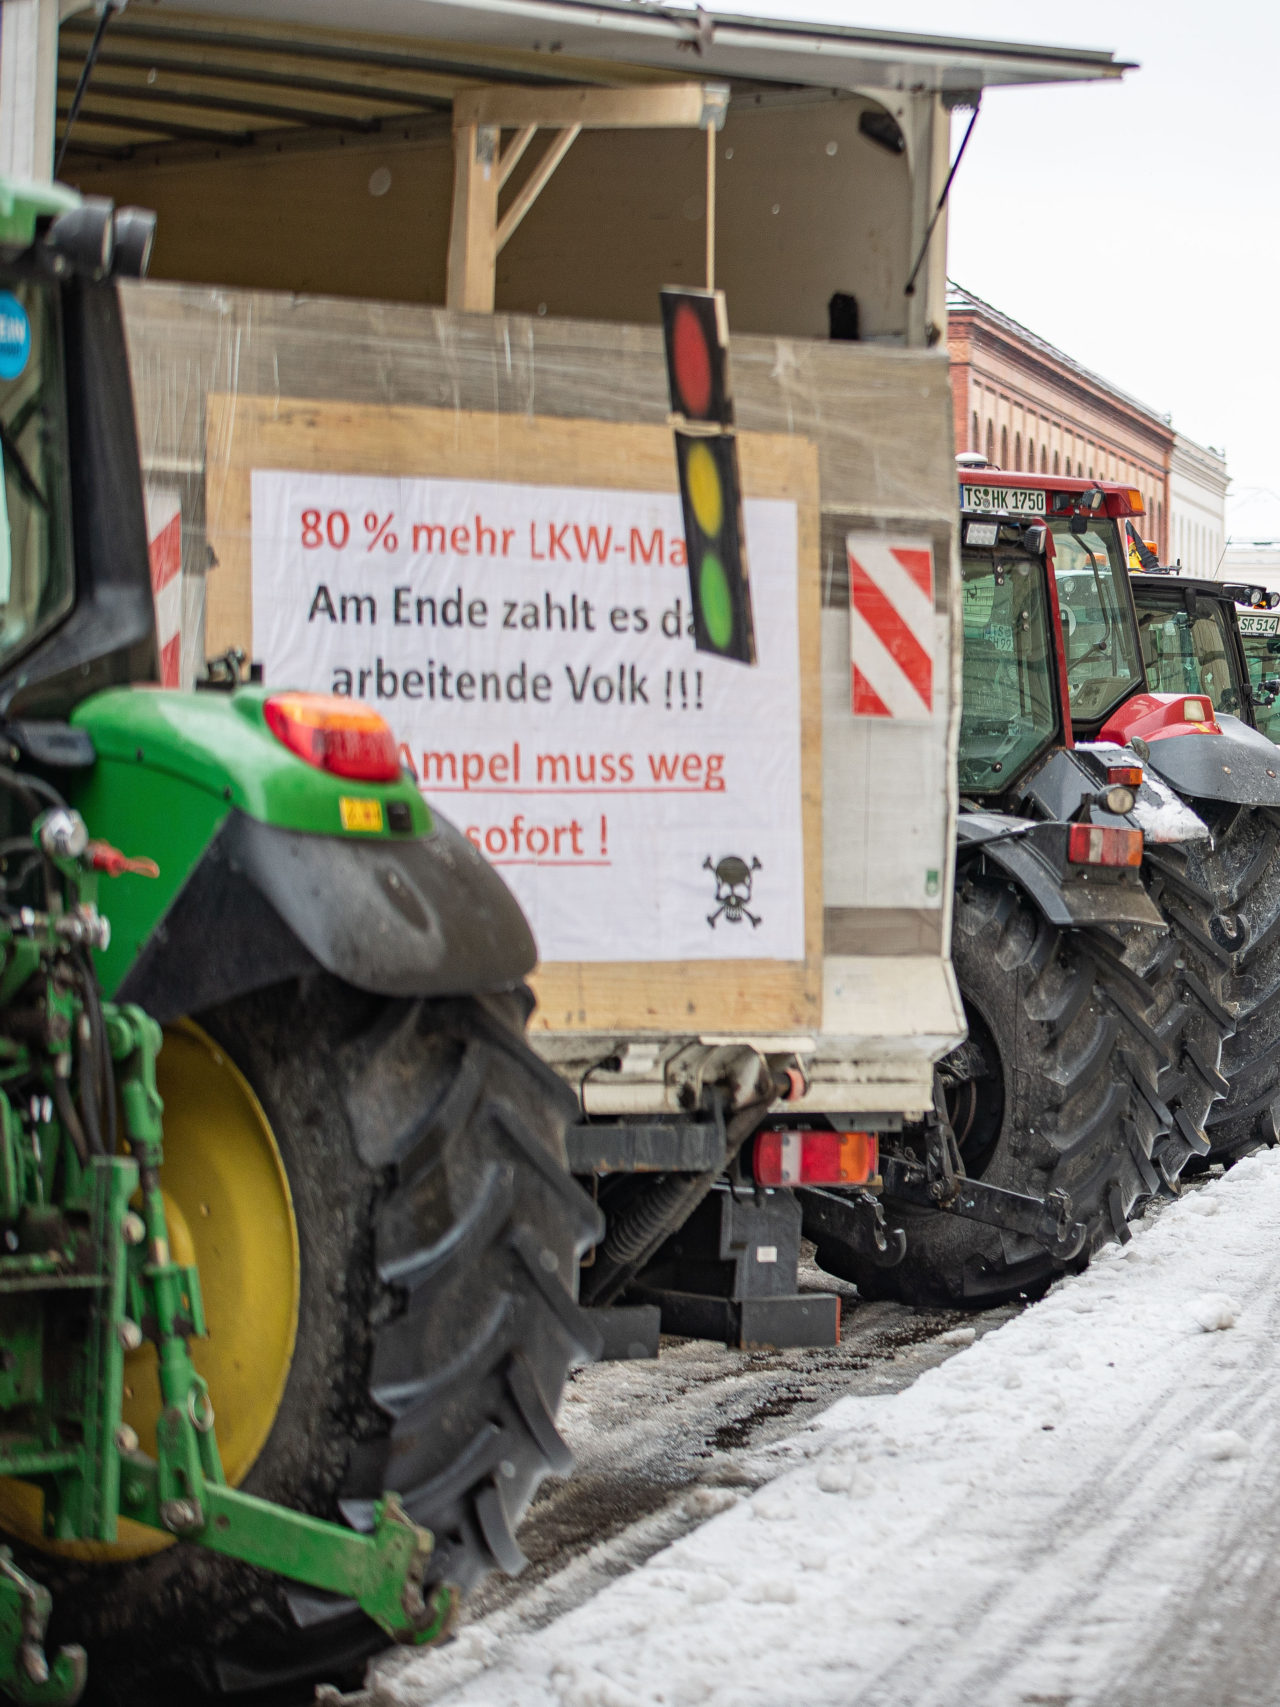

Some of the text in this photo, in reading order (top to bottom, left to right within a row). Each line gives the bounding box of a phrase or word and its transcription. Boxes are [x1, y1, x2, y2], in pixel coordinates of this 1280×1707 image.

[965, 487, 1044, 511] TS HK 1750
[301, 509, 689, 567] 80 % mehr LKW-Ma
[308, 585, 377, 625] Am
[393, 586, 488, 629] Ende
[502, 591, 595, 631] zahlt
[610, 606, 649, 633] es
[1240, 618, 1276, 632] SR 514
[332, 657, 703, 710] arbeitende Volk !!!
[536, 753, 634, 783] muss
[648, 753, 726, 791] weg
[465, 813, 608, 856] sofort !
